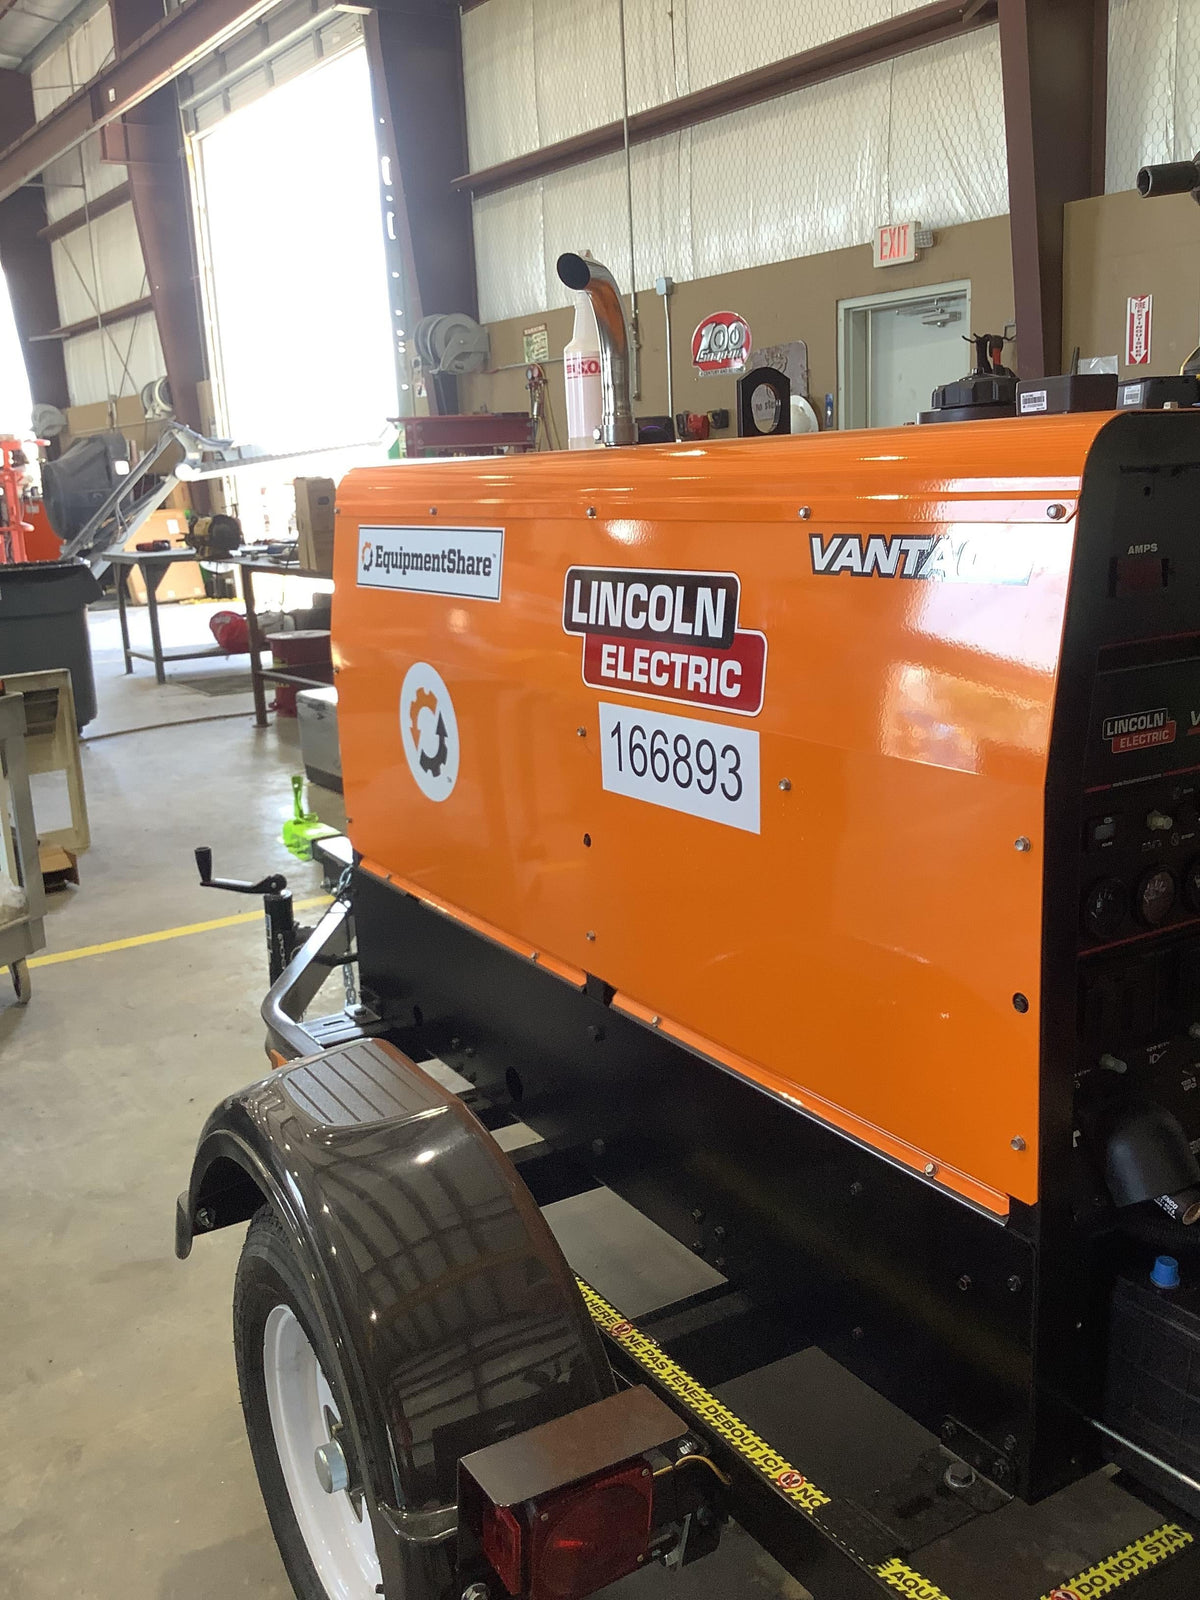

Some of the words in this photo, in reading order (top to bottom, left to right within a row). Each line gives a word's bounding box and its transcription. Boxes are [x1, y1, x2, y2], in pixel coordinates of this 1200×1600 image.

[880, 224, 909, 260] EXIT
[696, 320, 747, 361] 100
[375, 545, 492, 577] EquipmentShare
[1127, 542, 1158, 554] AMPS
[571, 579, 727, 638] LINCOLN
[600, 643, 743, 698] ELECTRIC
[1106, 712, 1164, 736] LINCOLN
[1120, 730, 1170, 749] ELECTRIC
[610, 720, 743, 802] 166893
[585, 1298, 618, 1325] HERE
[625, 1334, 647, 1350] NE
[641, 1349, 669, 1371] PAS
[666, 1369, 709, 1406] TENEZ
[704, 1404, 764, 1453] DEBOUT
[758, 1453, 784, 1472] ICI
[889, 1571, 940, 1600] AQU
[1075, 1575, 1107, 1596] DO
[1104, 1551, 1144, 1578] NOT
